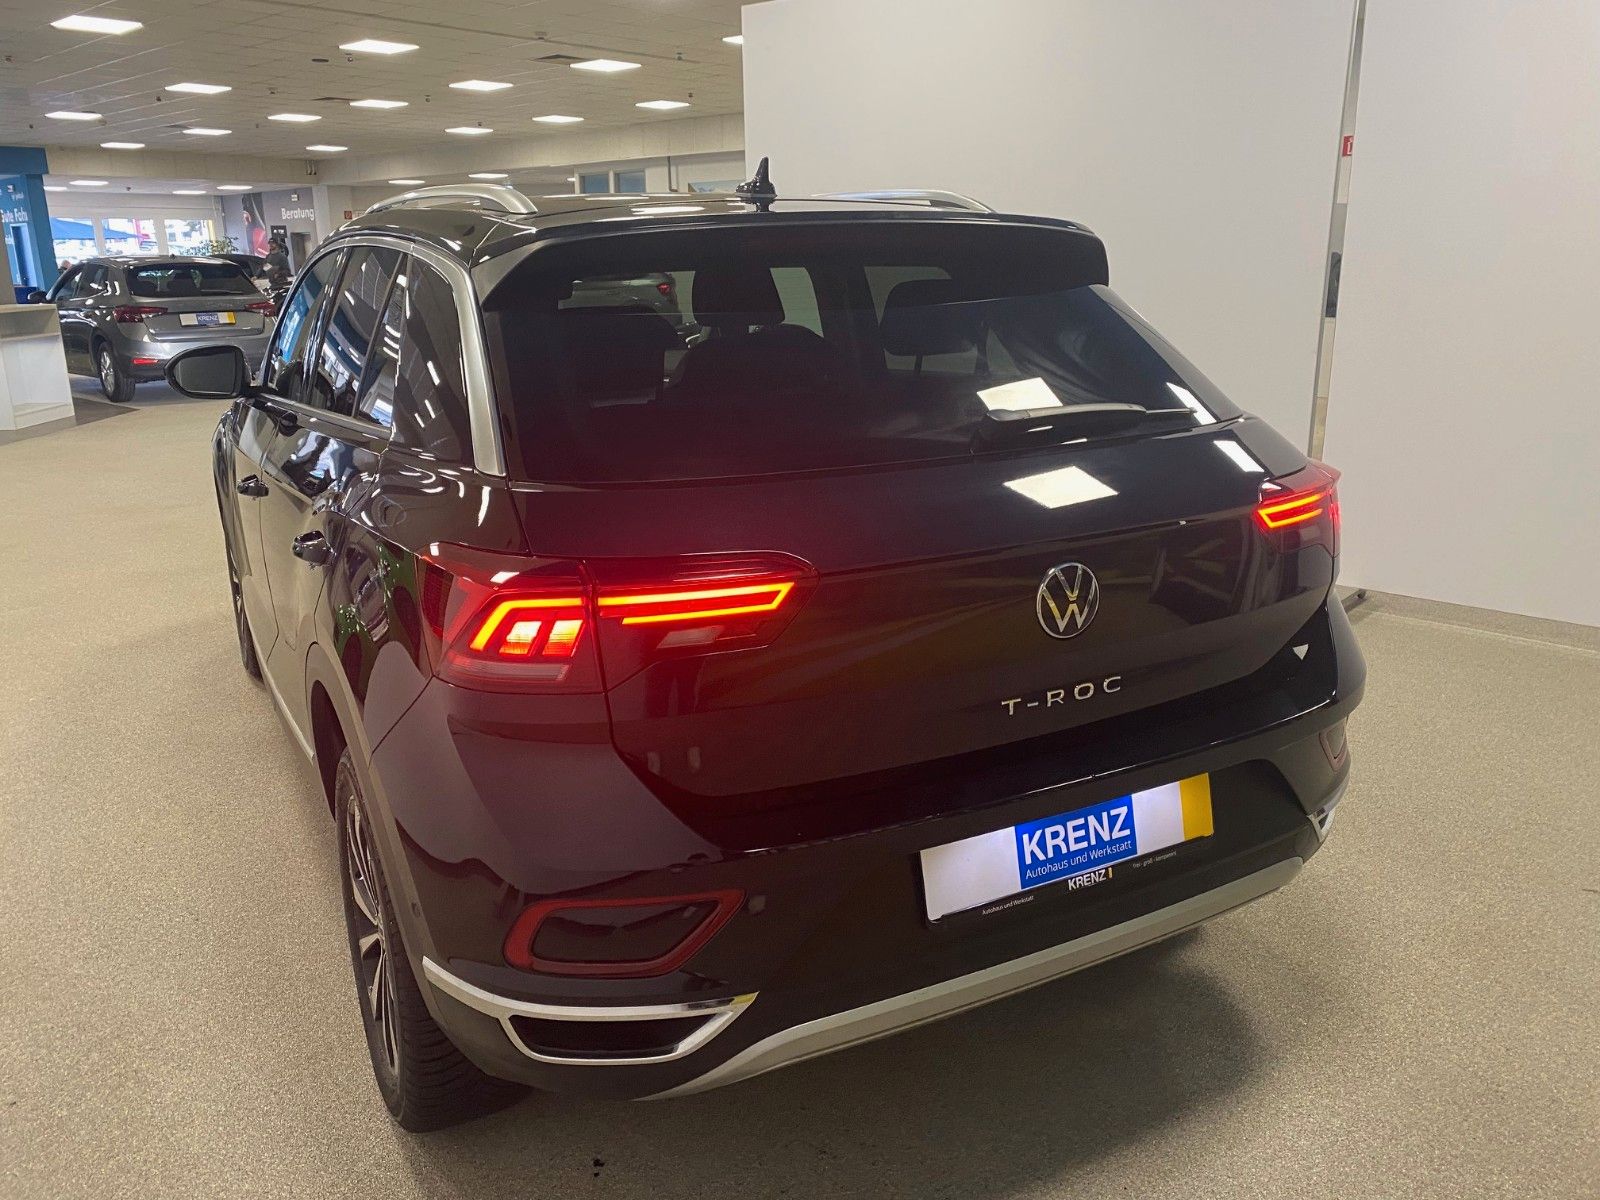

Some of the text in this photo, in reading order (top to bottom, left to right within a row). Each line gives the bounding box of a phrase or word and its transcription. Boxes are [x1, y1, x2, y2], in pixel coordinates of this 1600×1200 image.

[281, 208, 314, 221] Beratung
[1001, 676, 1121, 715] T-ROC
[1022, 806, 1131, 865] KRENZ
[1025, 840, 1132, 880] Autohaus und Werkstatt
[1067, 868, 1107, 891] KRENZ
[982, 895, 1034, 915] Autohaus und Werkstatt
